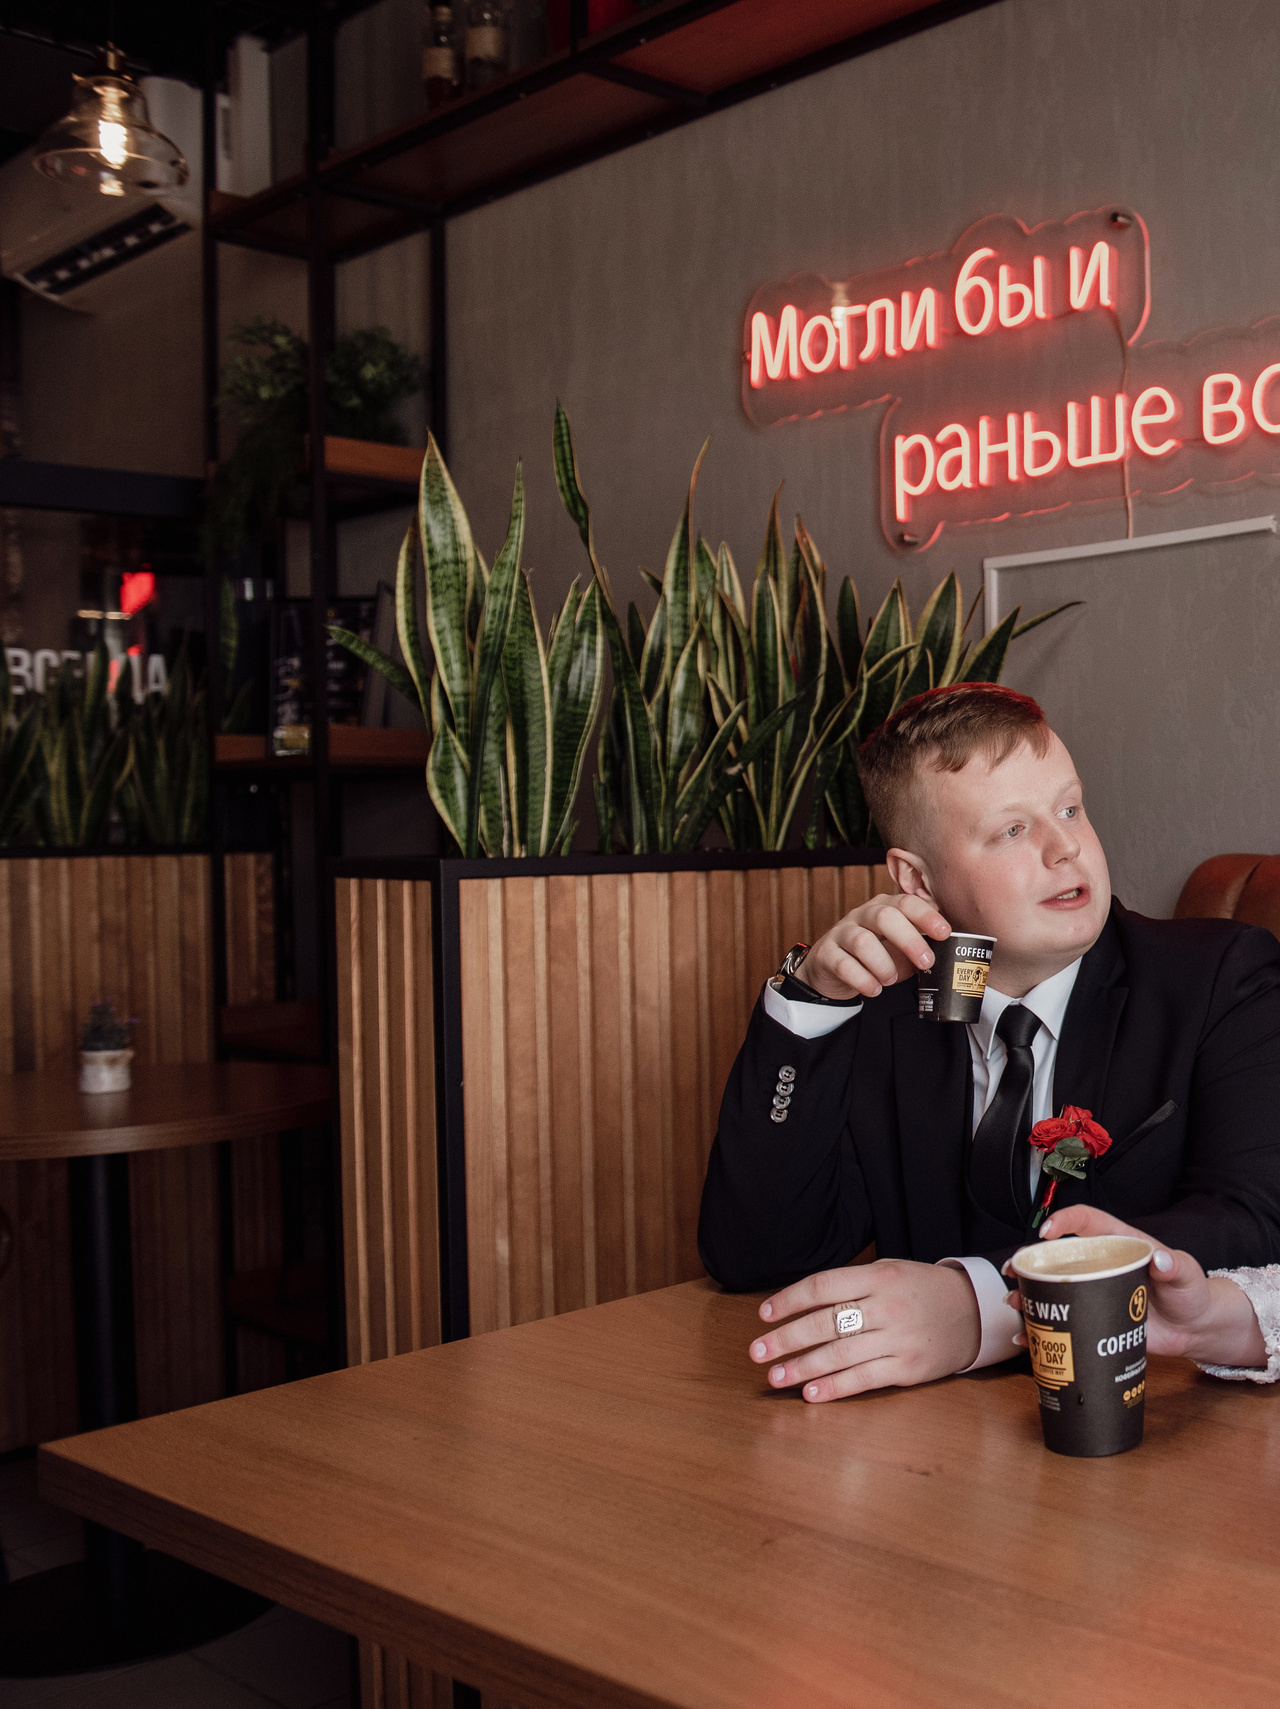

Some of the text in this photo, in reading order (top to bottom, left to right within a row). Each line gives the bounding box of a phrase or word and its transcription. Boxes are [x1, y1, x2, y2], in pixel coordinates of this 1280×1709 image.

[751, 241, 1112, 388] Могли бы и
[895, 387, 1177, 521] раньше
[956, 947, 985, 958] COFFEE
[1035, 1301, 1070, 1321] WAY
[1041, 1340, 1066, 1353] GOOD
[1097, 1324, 1144, 1357] COFFEE
[1046, 1352, 1064, 1365] DAY
